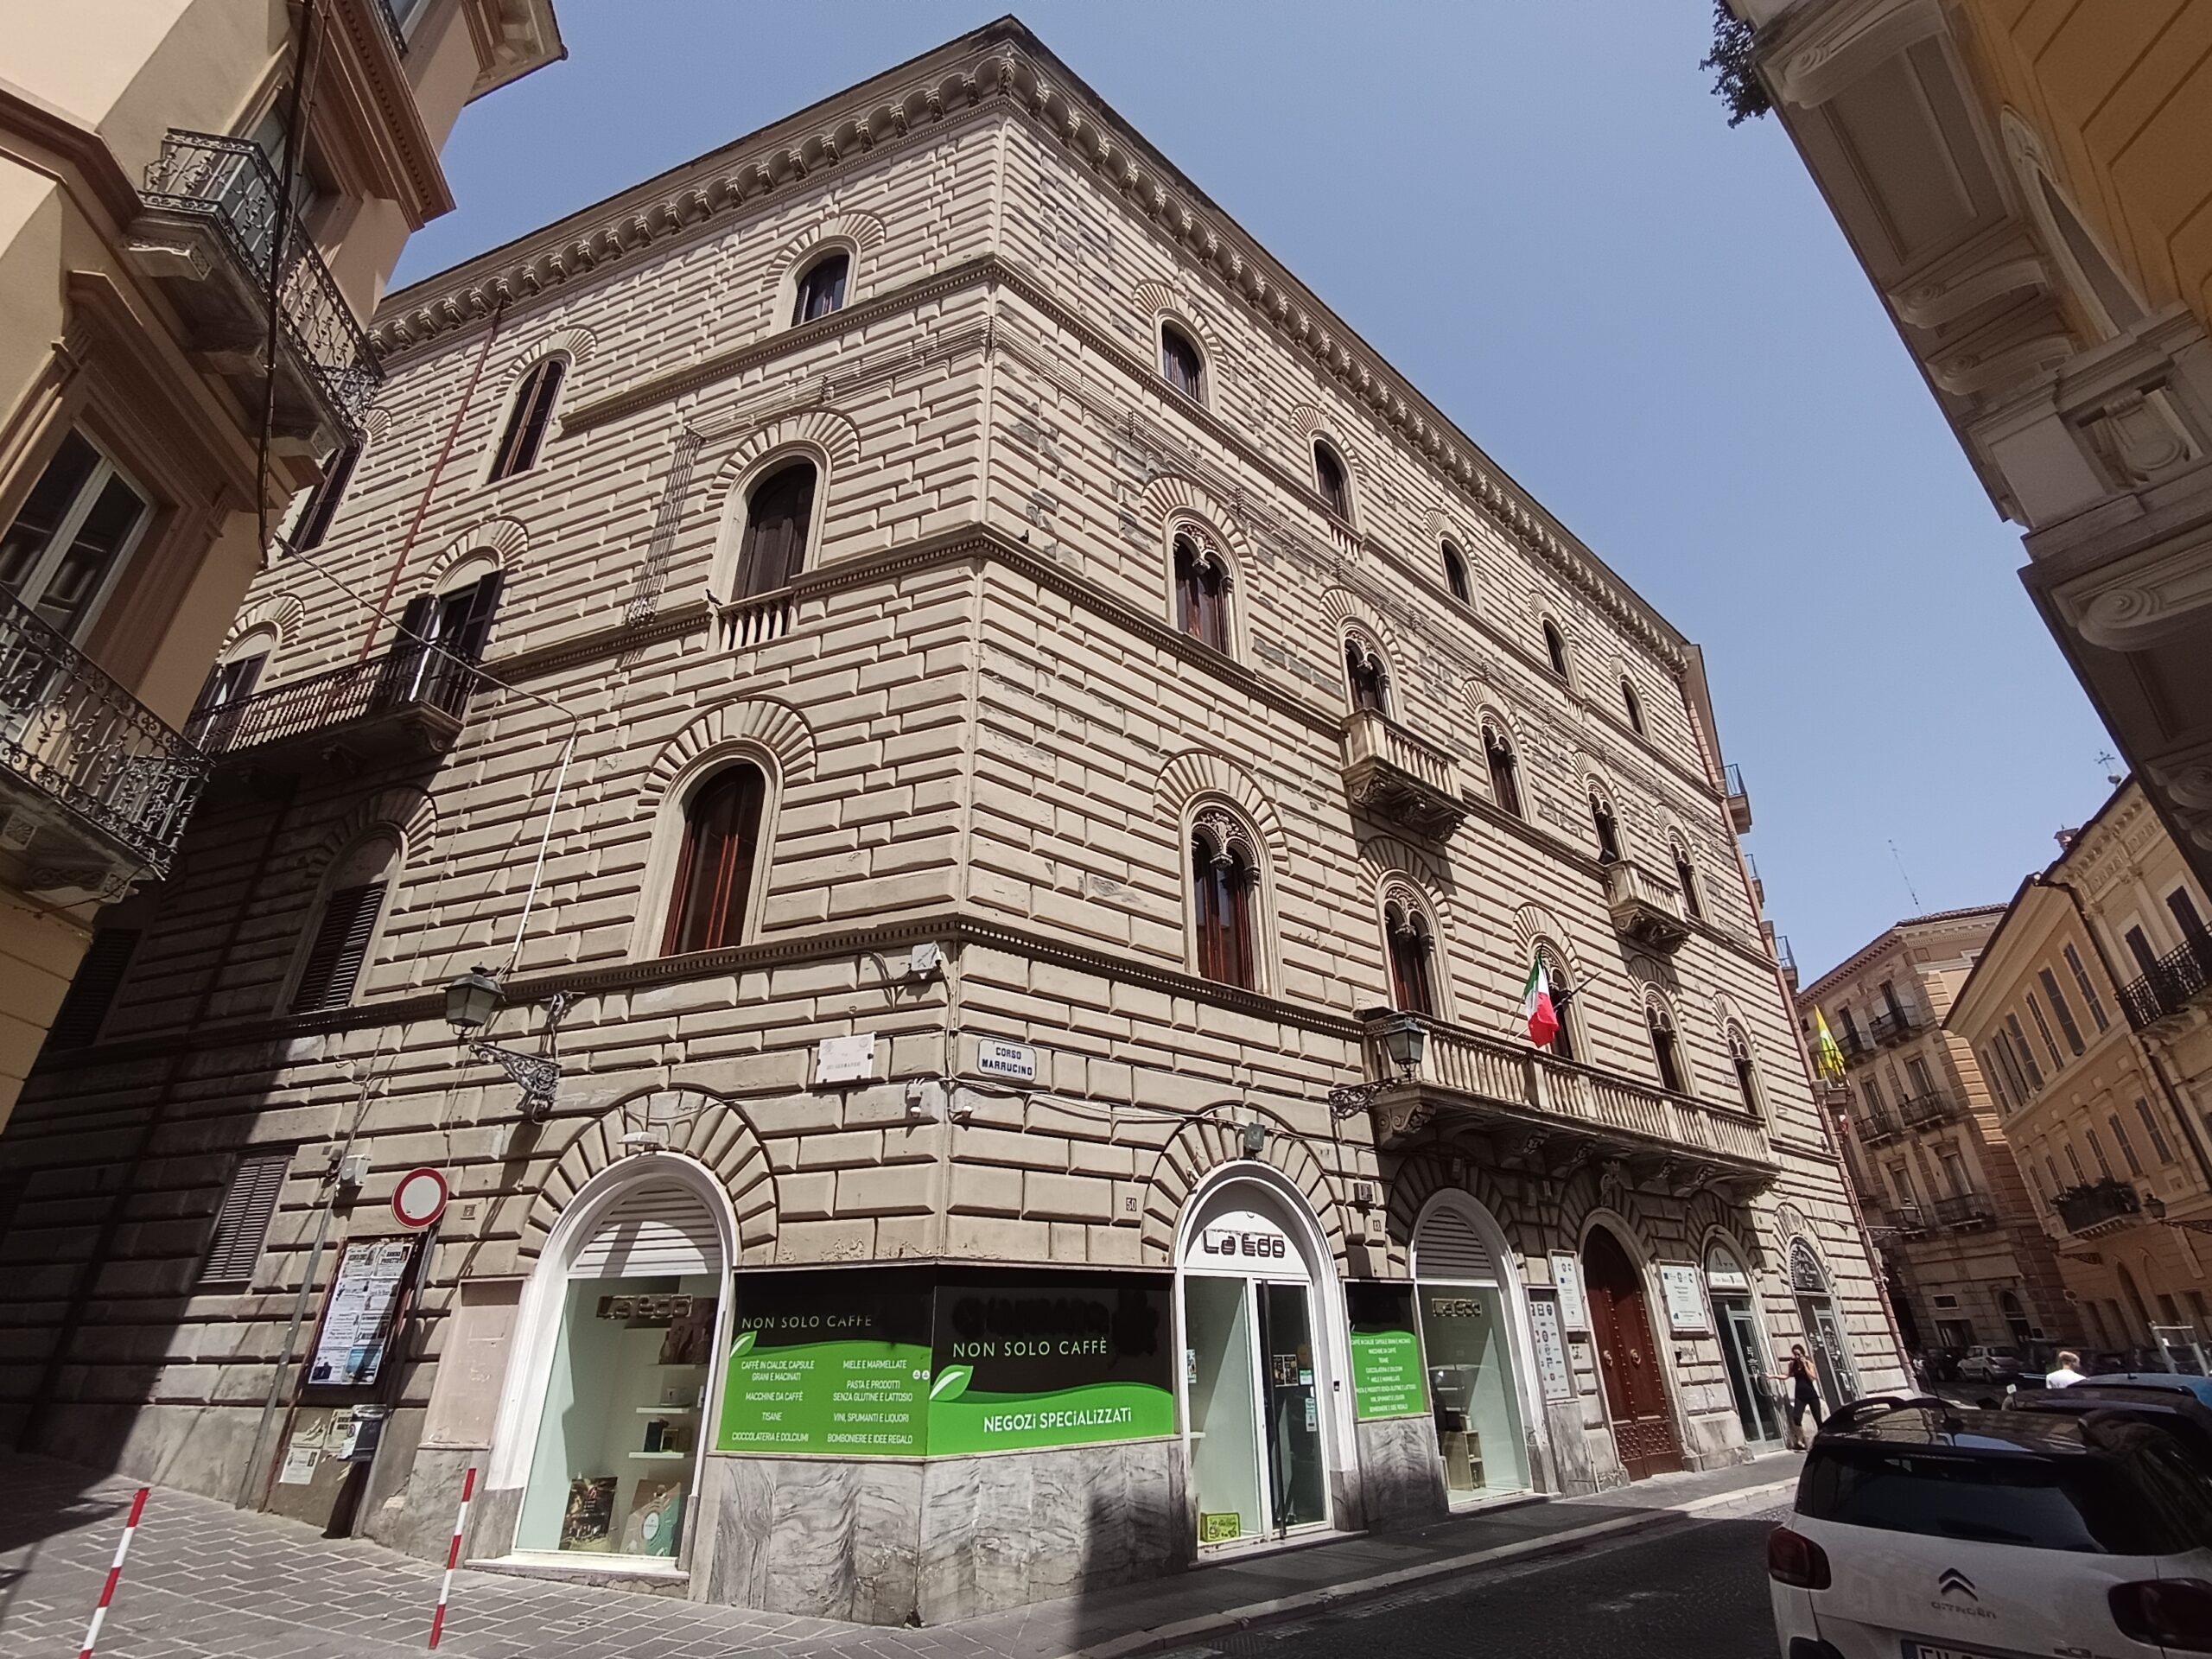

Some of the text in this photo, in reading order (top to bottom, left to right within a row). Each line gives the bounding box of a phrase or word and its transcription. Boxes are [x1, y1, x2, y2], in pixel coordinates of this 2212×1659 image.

[996, 1047, 1021, 1059] CORSO
[982, 1058, 1033, 1076] MARRUCINO
[1127, 1198, 1136, 1211] 50
[1203, 1230, 1236, 1255] La
[741, 1317, 775, 1329] NON
[781, 1316, 820, 1328] SOLO
[953, 1337, 1107, 1357] NON SOLO CAFFÈ
[788, 1361, 815, 1370] CAPSULE
[843, 1360, 861, 1369] MIELE
[867, 1360, 907, 1369] MARMELLATE
[752, 1372, 769, 1381] GRANI
[774, 1372, 801, 1381] MACINATI
[847, 1380, 865, 1389] PASTA
[870, 1380, 900, 1389] PRODOTTI
[746, 1392, 775, 1401] MACCHINE
[775, 1392, 784, 1401] DA
[833, 1393, 853, 1402] SENZA
[854, 1393, 879, 1402] GLUTINE
[885, 1393, 912, 1402] LATTOSIO
[762, 1412, 782, 1421] TISANE
[848, 1413, 878, 1422] SPUMANTI
[884, 1414, 909, 1423] LIQUORI
[732, 1432, 775, 1441] CIOCCOLATERIA
[780, 1433, 809, 1442] DOLCIUMI
[828, 1433, 867, 1443] BOMBONIERE
[873, 1434, 887, 1444] IDEE
[888, 1434, 912, 1444] REGALO
